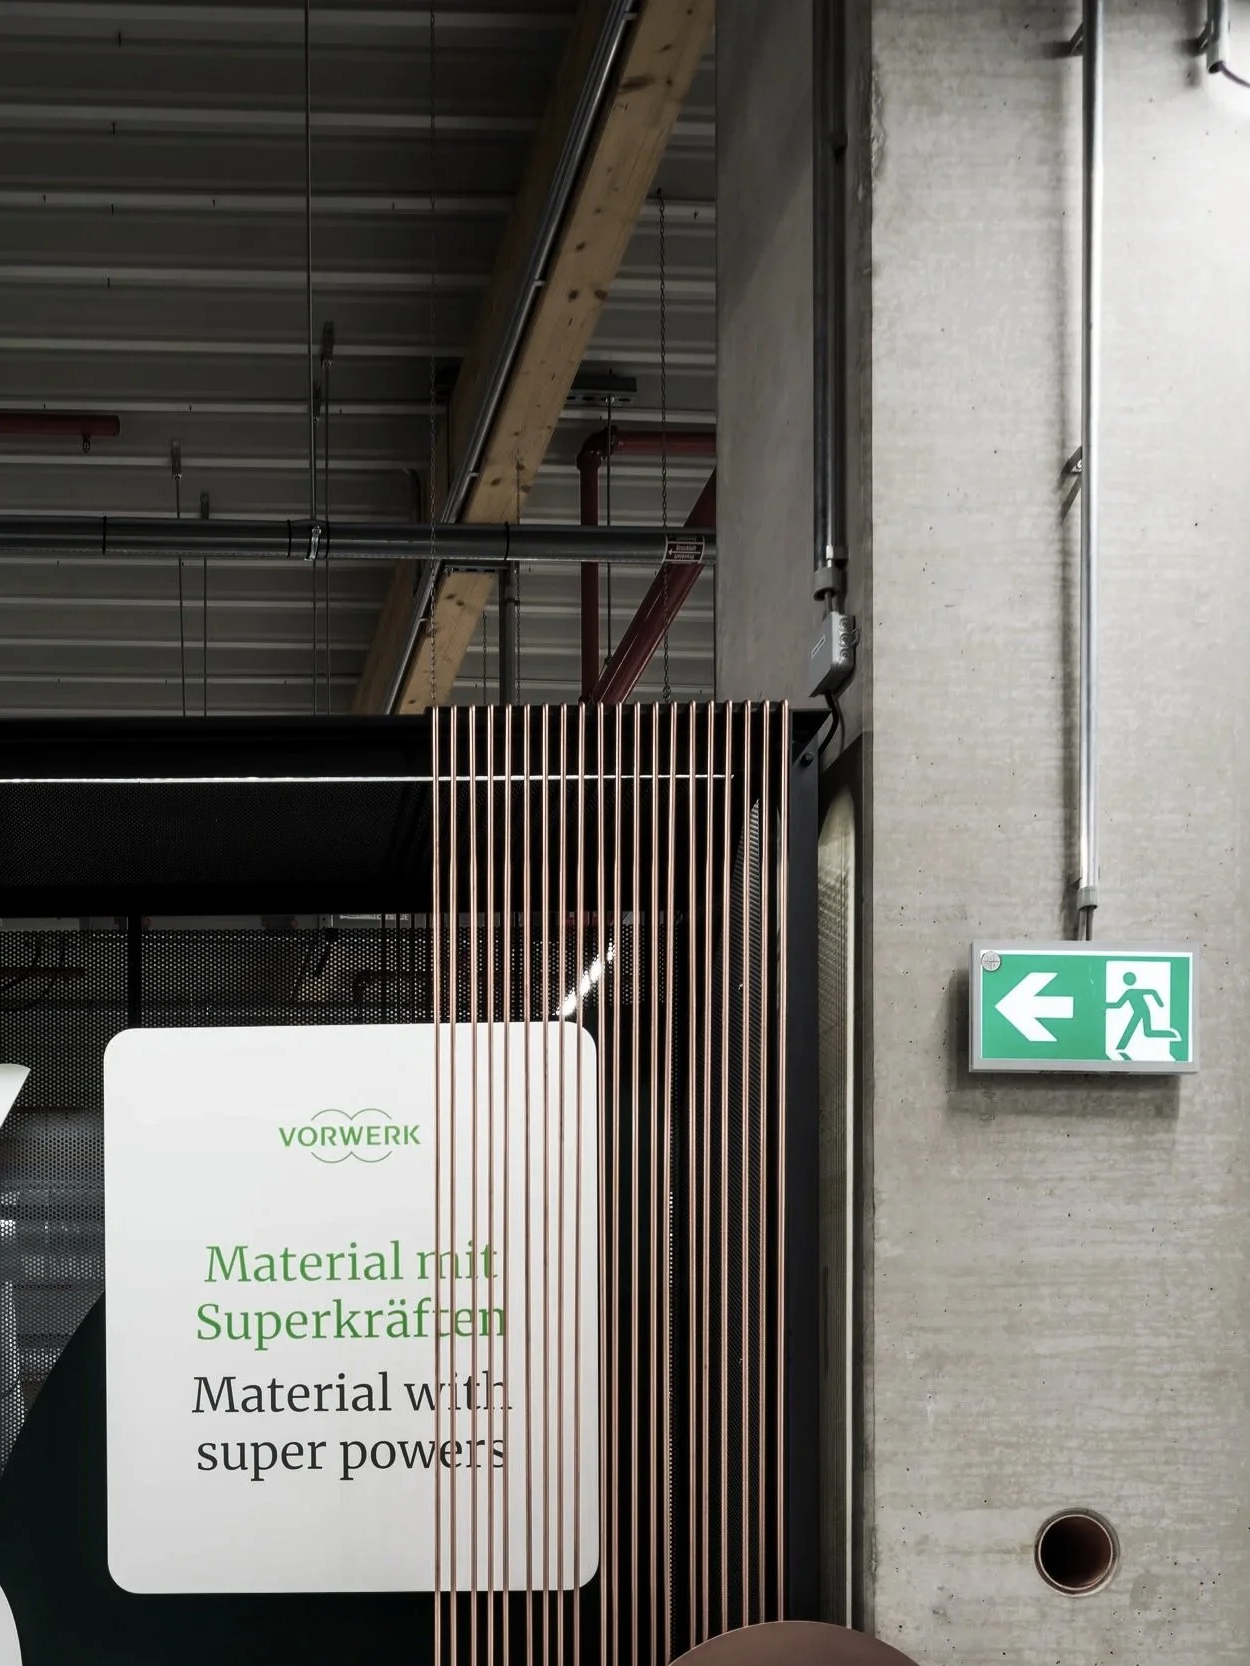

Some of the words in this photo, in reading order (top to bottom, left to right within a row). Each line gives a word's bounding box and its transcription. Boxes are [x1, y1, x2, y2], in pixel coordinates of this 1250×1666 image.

[278, 1124, 421, 1148] VORWERK
[204, 1240, 405, 1283] Material
[417, 1239, 499, 1280] mit
[196, 1297, 509, 1351] Superkräften
[191, 1371, 393, 1414] Material
[403, 1369, 513, 1412] with
[196, 1440, 327, 1482] super
[339, 1438, 508, 1481] powers
